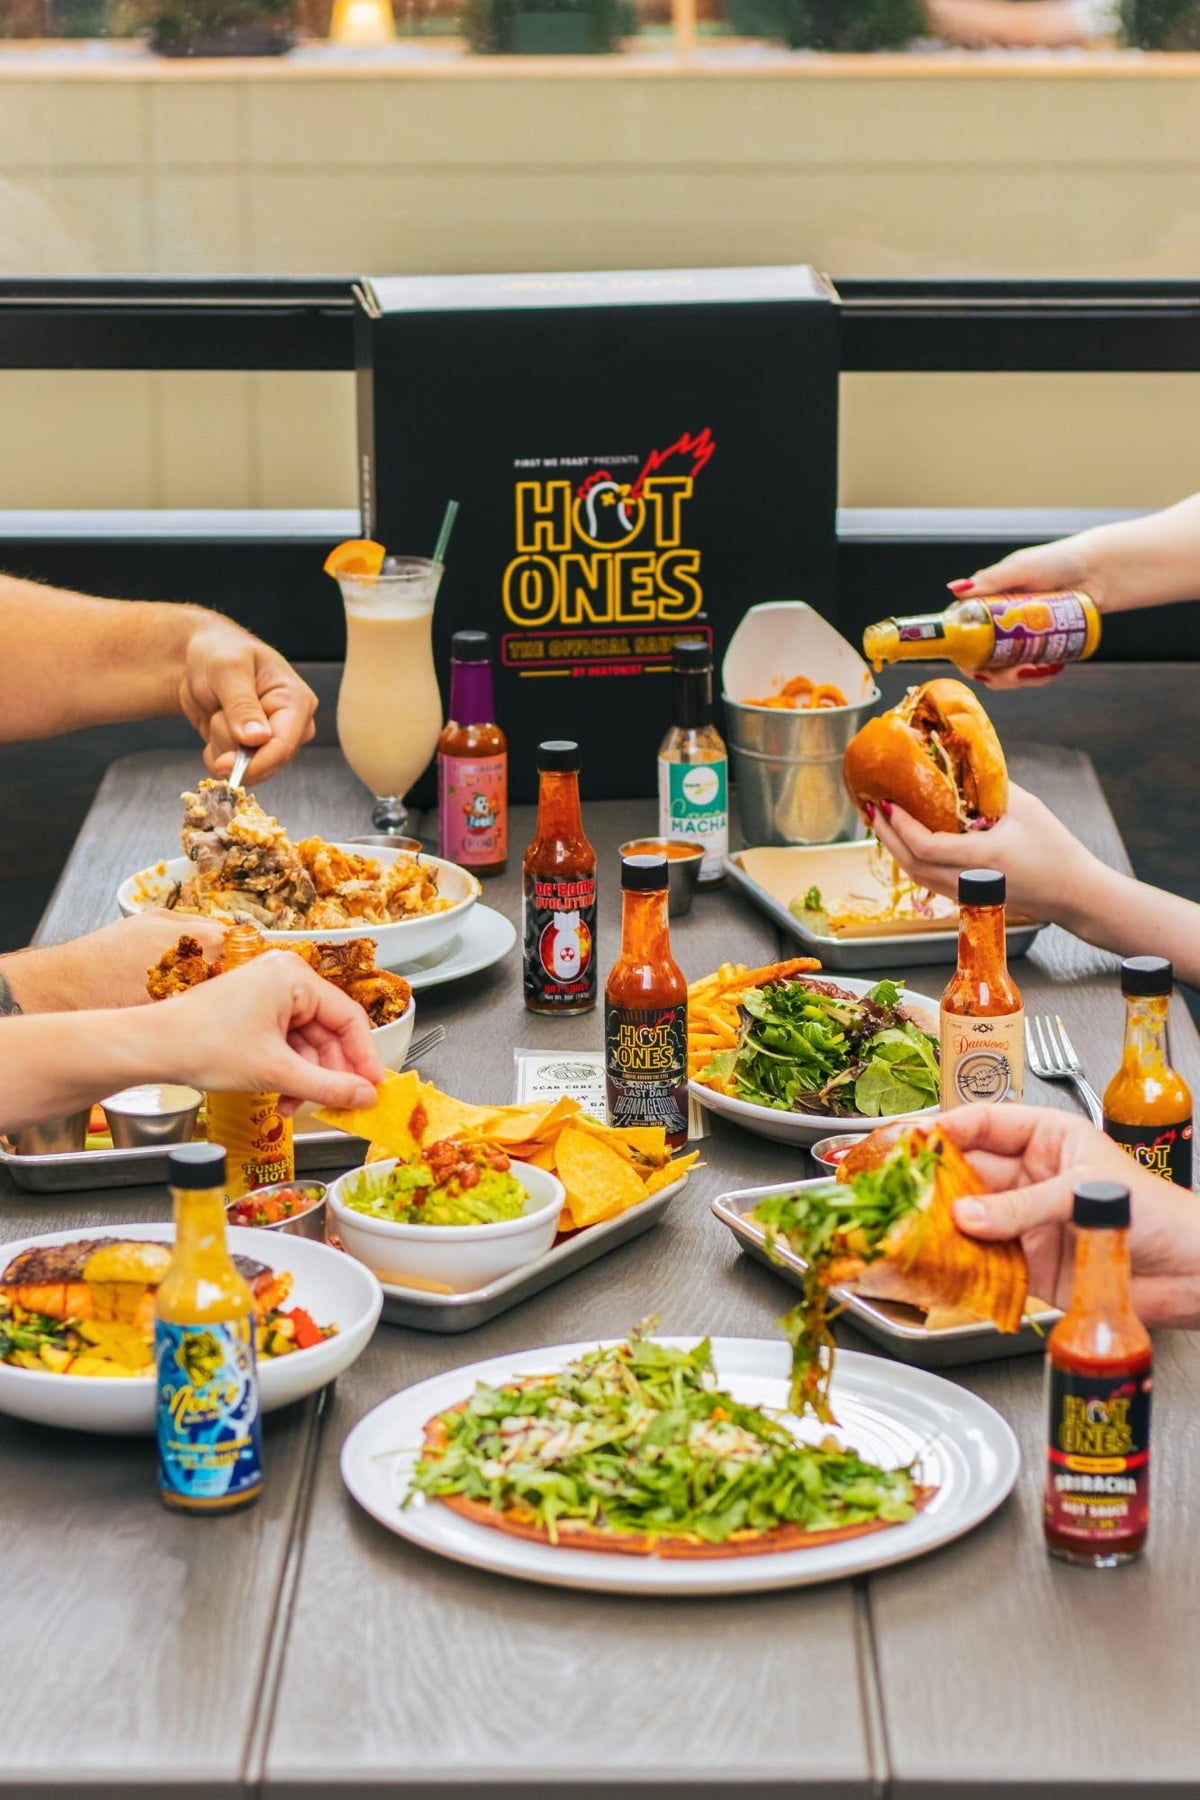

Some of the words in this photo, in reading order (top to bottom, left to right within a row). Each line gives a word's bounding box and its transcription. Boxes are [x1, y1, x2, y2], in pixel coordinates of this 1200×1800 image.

[593, 455, 639, 464] PRESENTS
[515, 475, 694, 552] HOT
[502, 549, 703, 626] ONES
[509, 641, 544, 658] THE
[549, 638, 630, 656] OFFICIAL
[671, 817, 727, 833] MACHA
[544, 984, 561, 993] HOT
[565, 982, 591, 993] SAUCE
[620, 1024, 670, 1047] HOT
[953, 1034, 1010, 1054] Dawson's
[617, 1046, 673, 1069] ONES
[624, 1088, 646, 1098] LAST
[649, 1088, 668, 1097] DAB
[613, 1095, 680, 1115] THERMAGEDDON
[258, 1169, 287, 1184] HOT
[1063, 1395, 1130, 1425] HOT
[1059, 1423, 1132, 1455] ONES
[1055, 1474, 1137, 1494] SRIRACHA
[1060, 1500, 1087, 1515] HOT
[1089, 1502, 1129, 1517] SAUCE
